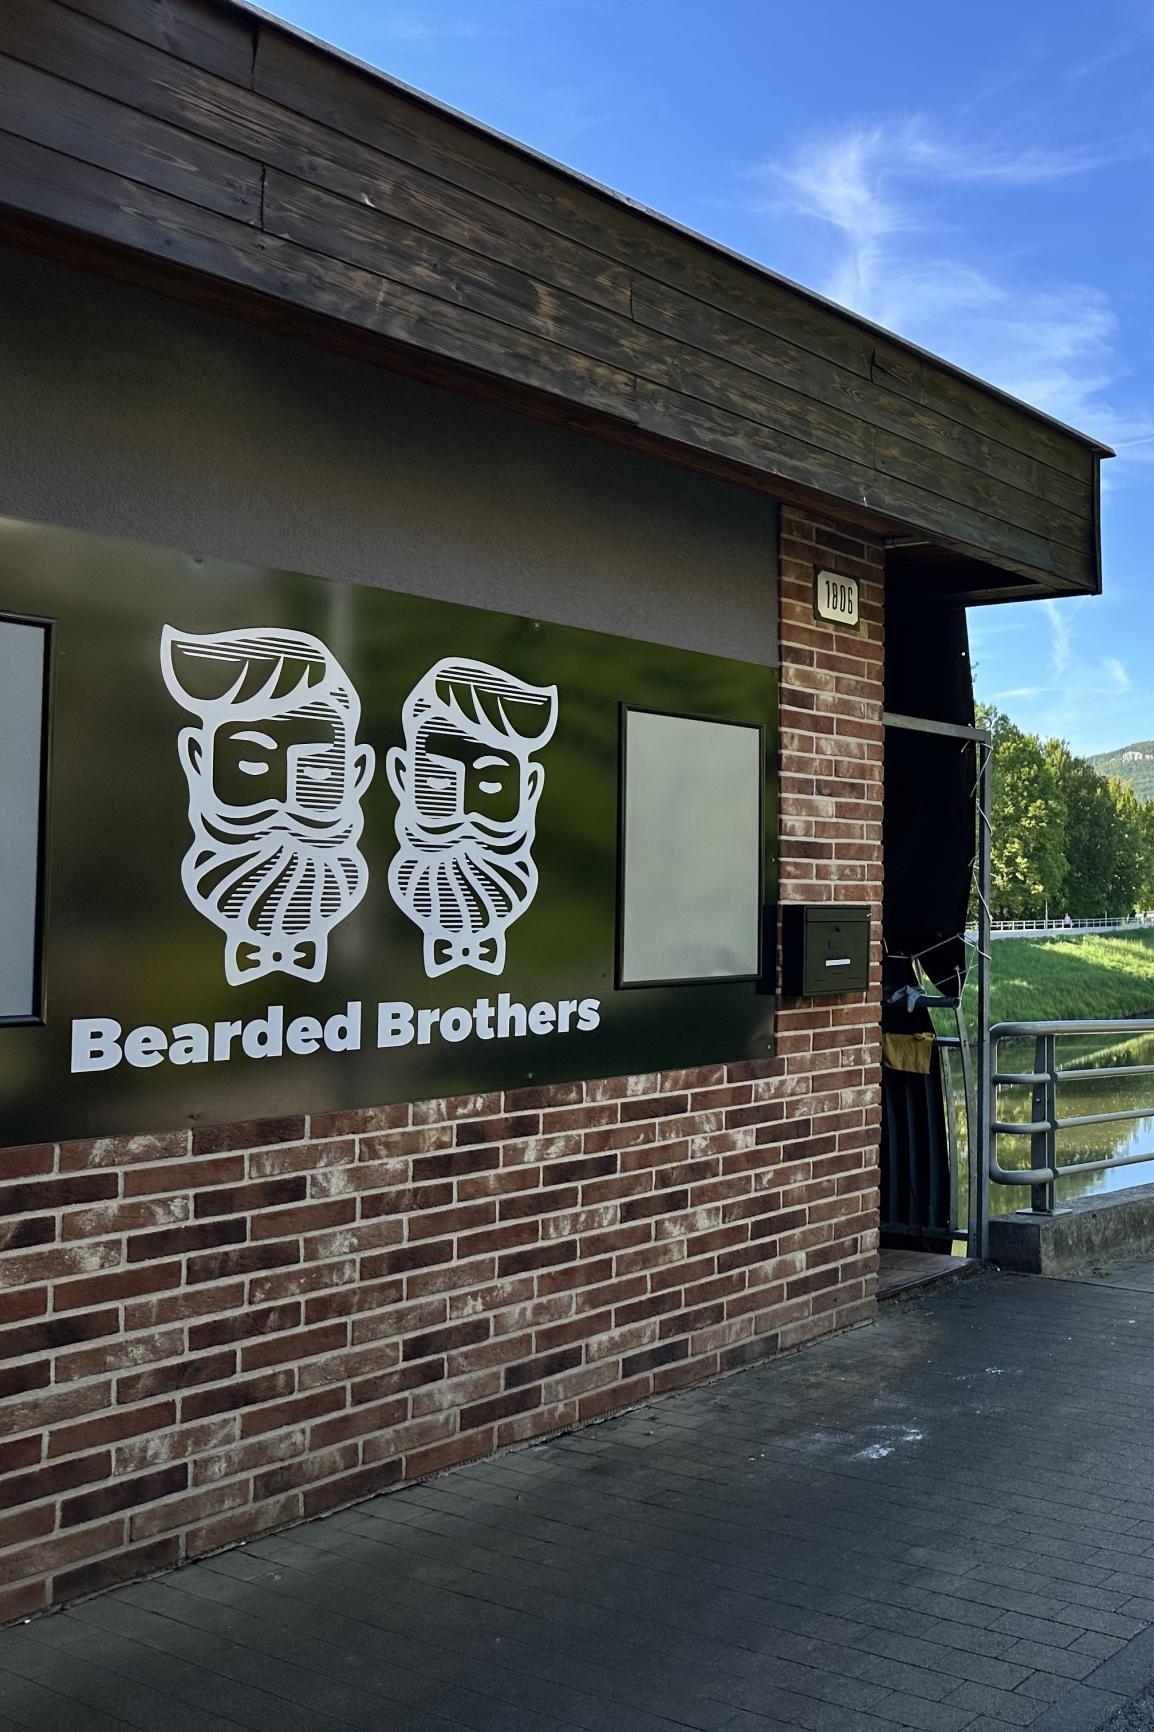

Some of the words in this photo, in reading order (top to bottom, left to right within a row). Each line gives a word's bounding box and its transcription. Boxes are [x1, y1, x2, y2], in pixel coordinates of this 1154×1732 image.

[825, 580, 853, 614] 1806
[70, 1001, 362, 1073] Bearded
[377, 993, 600, 1048] Brothers
